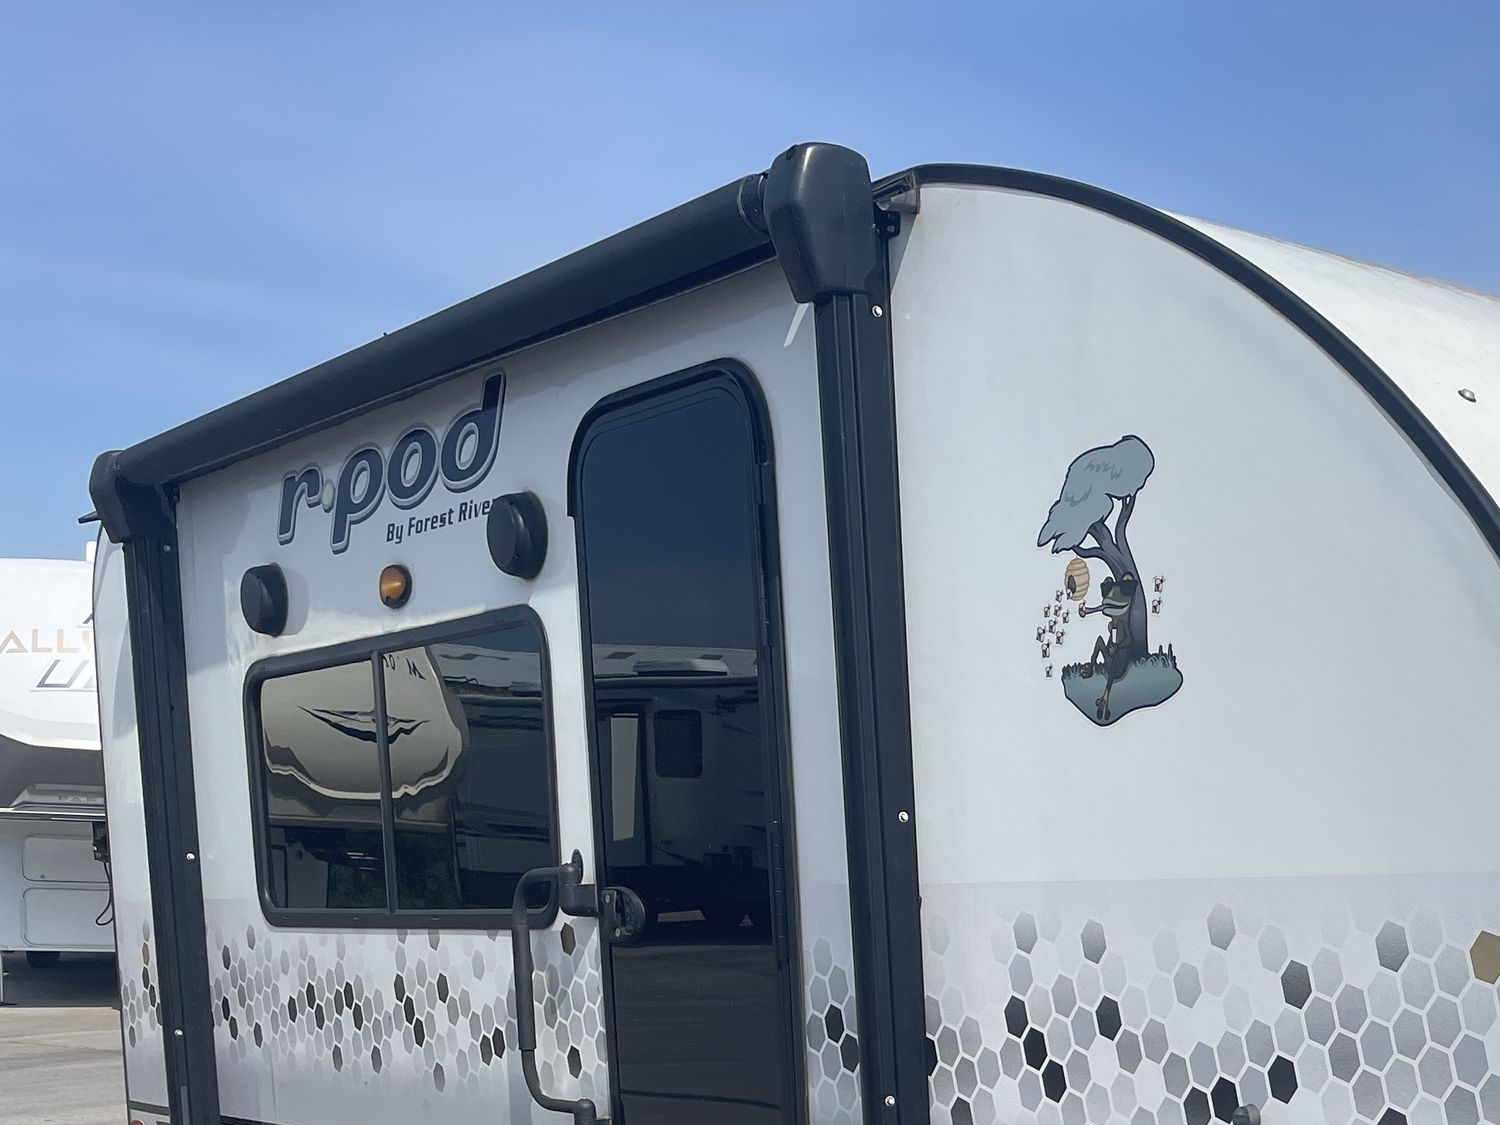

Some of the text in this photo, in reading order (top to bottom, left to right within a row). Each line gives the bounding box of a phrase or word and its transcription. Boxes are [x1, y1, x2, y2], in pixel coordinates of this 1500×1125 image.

[386, 499, 494, 545] By Forest Rive
